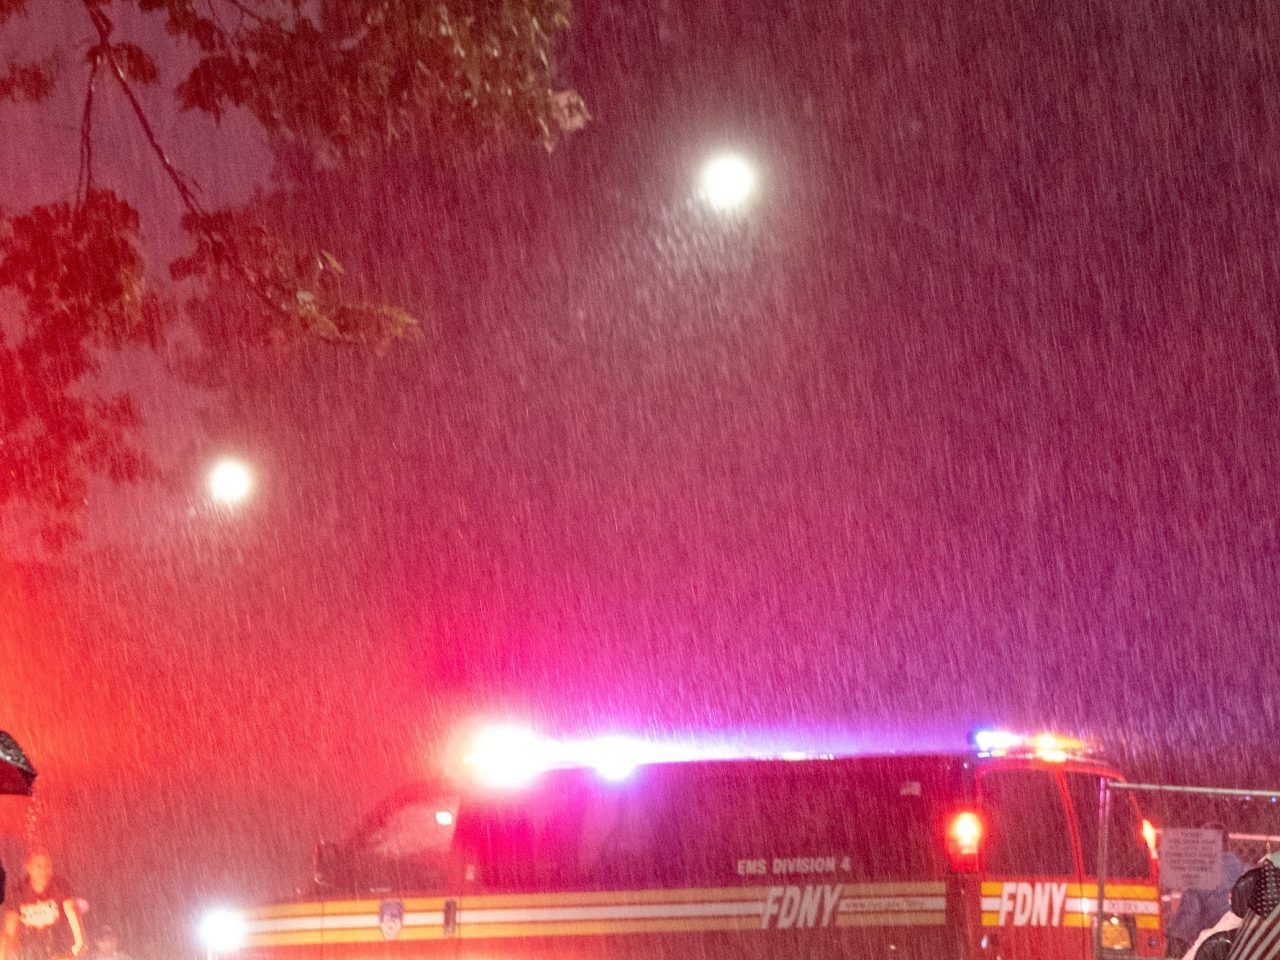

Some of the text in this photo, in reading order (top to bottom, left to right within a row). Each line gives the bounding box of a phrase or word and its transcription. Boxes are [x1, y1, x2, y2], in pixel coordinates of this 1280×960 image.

[737, 856, 851, 876] EMS DIVISION 4
[761, 884, 842, 929] FDNY
[999, 882, 1067, 927] FDNY
